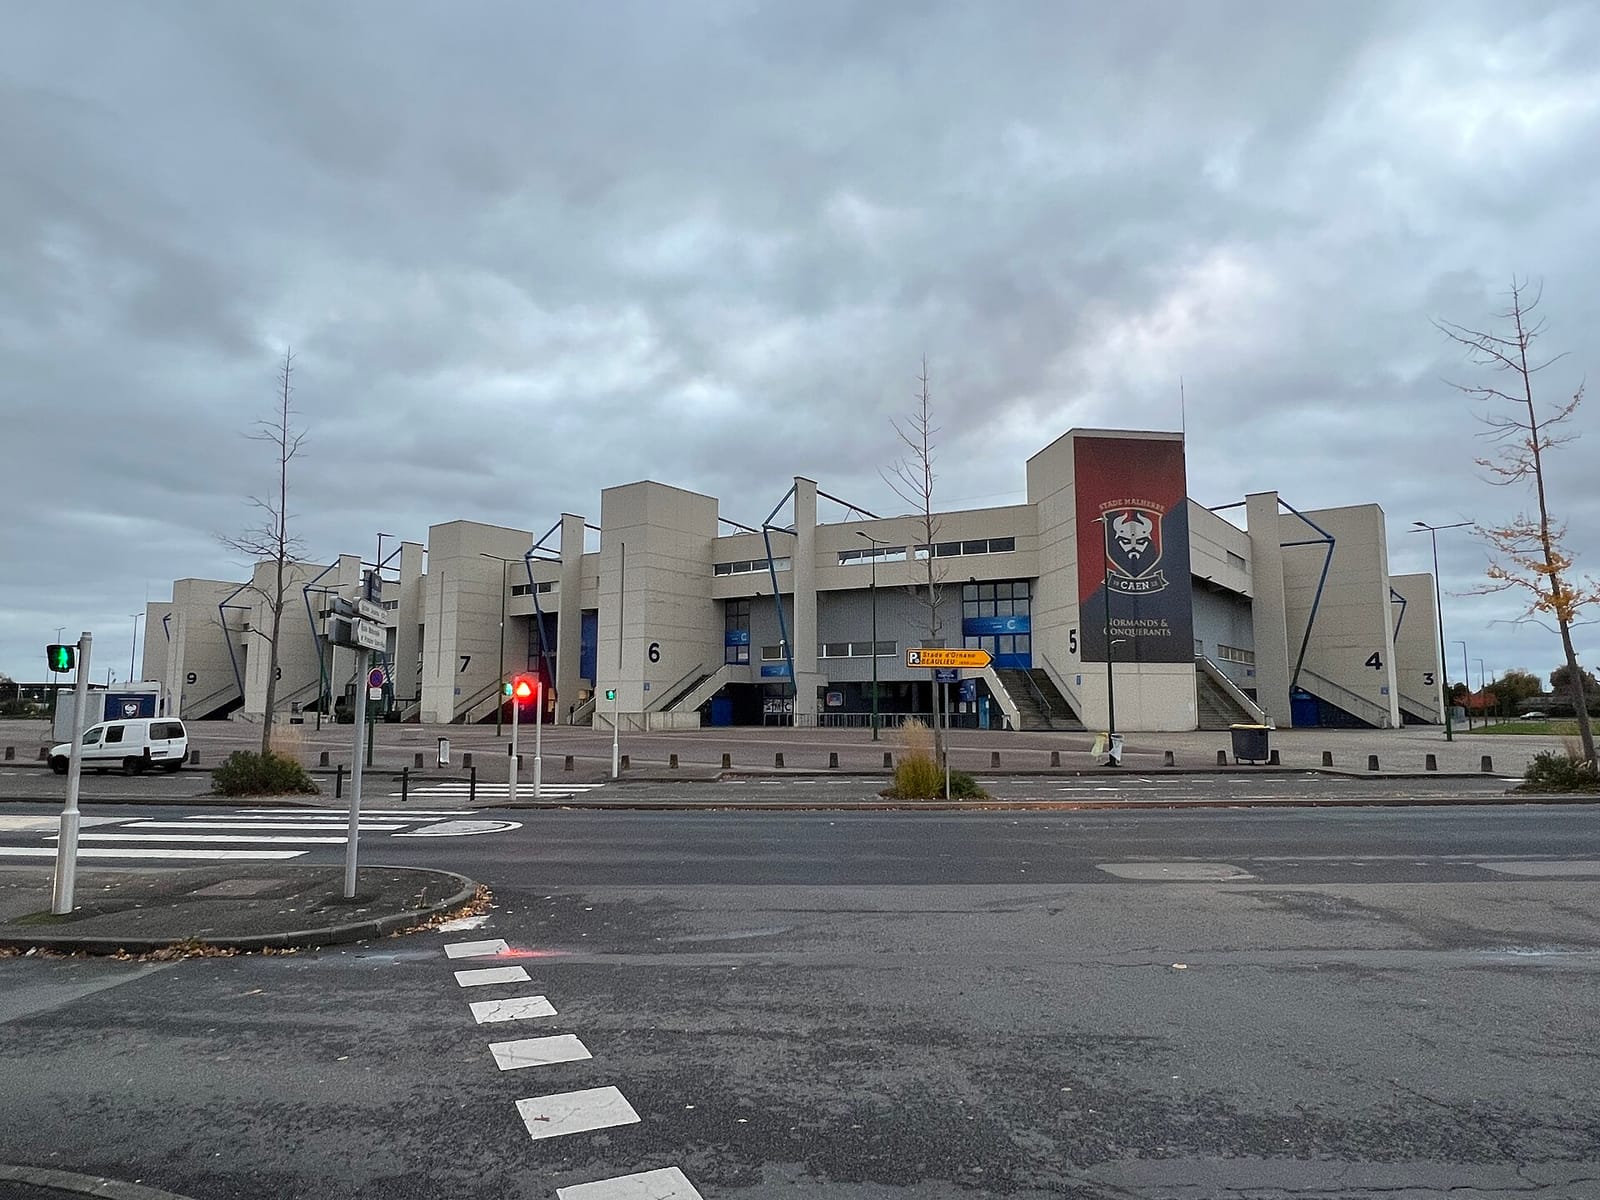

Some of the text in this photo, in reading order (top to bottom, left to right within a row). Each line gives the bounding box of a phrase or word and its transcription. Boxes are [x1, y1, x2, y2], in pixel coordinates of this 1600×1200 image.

[1099, 499, 1123, 510] STADE
[1120, 581, 1149, 590] CAEN
[1069, 629, 1077, 654] 5
[648, 642, 660, 663] 6
[460, 655, 471, 673] 7
[1365, 652, 1383, 670] 4
[186, 672, 197, 685] 9
[1423, 672, 1434, 686] 3
